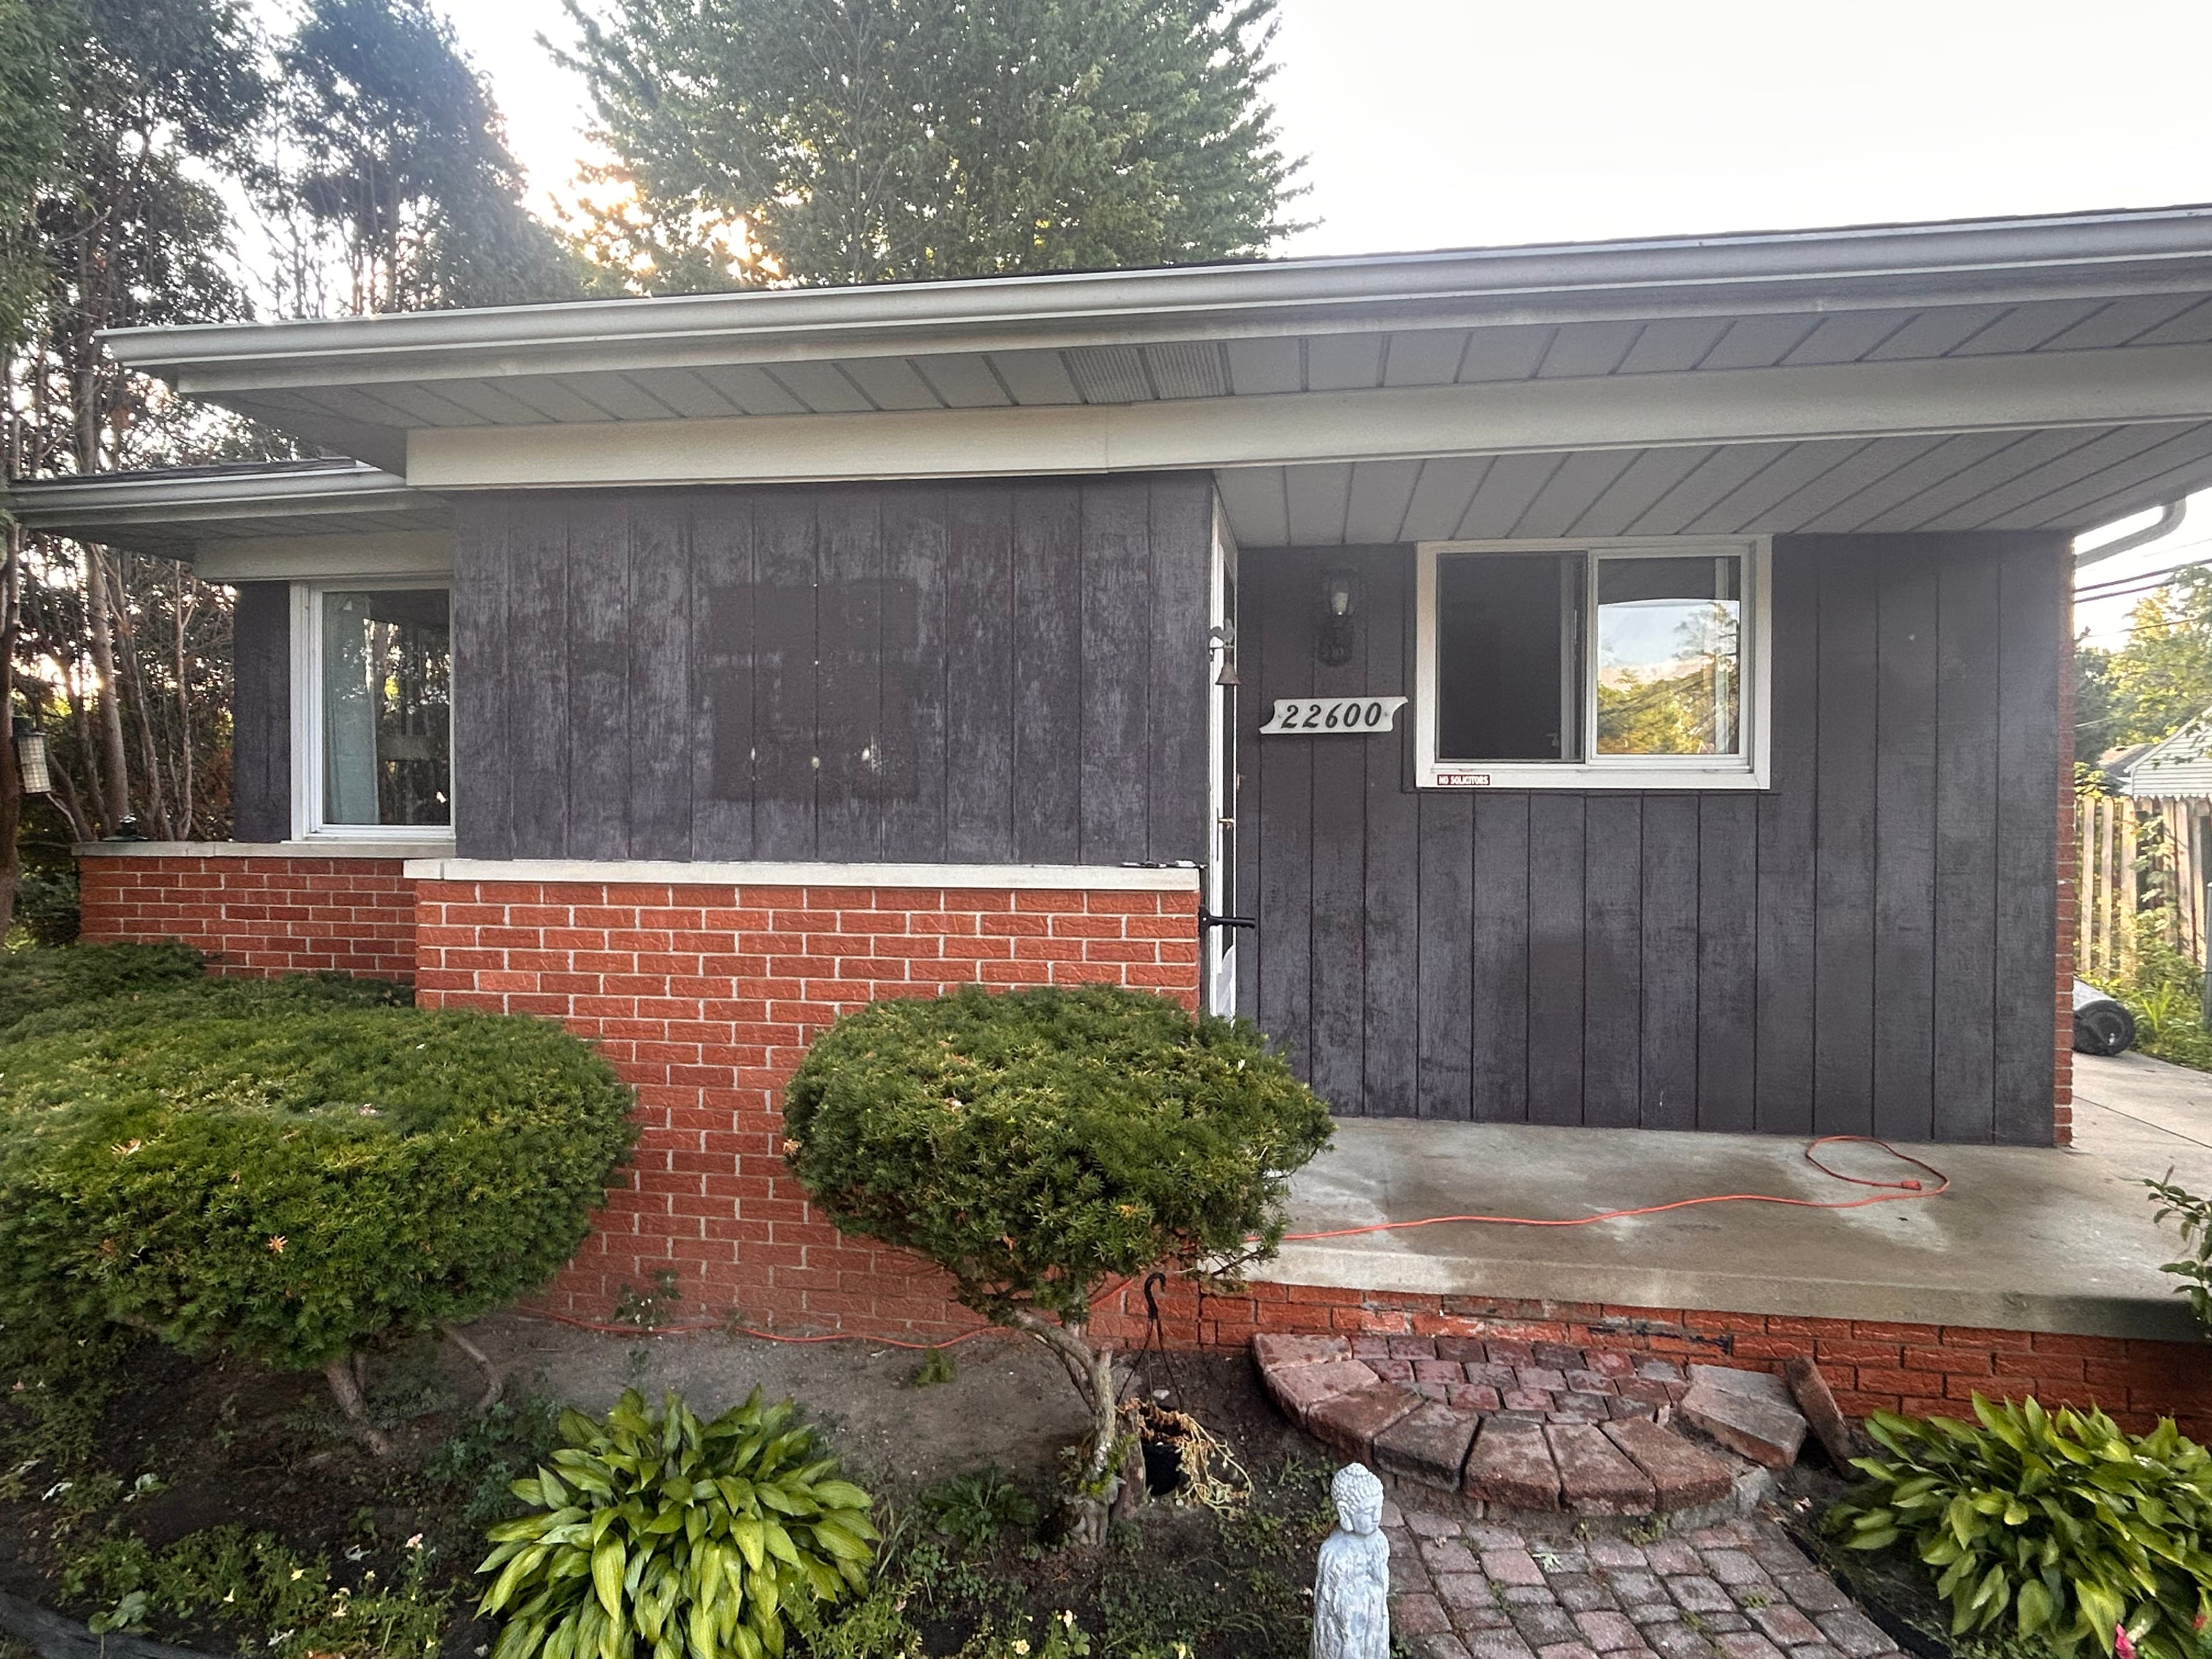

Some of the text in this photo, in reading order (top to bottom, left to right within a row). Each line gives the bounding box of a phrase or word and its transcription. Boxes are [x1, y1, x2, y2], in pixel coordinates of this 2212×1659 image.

[1281, 702, 1381, 728] 22600
[1439, 775, 1489, 784] NO SOLICITORS
